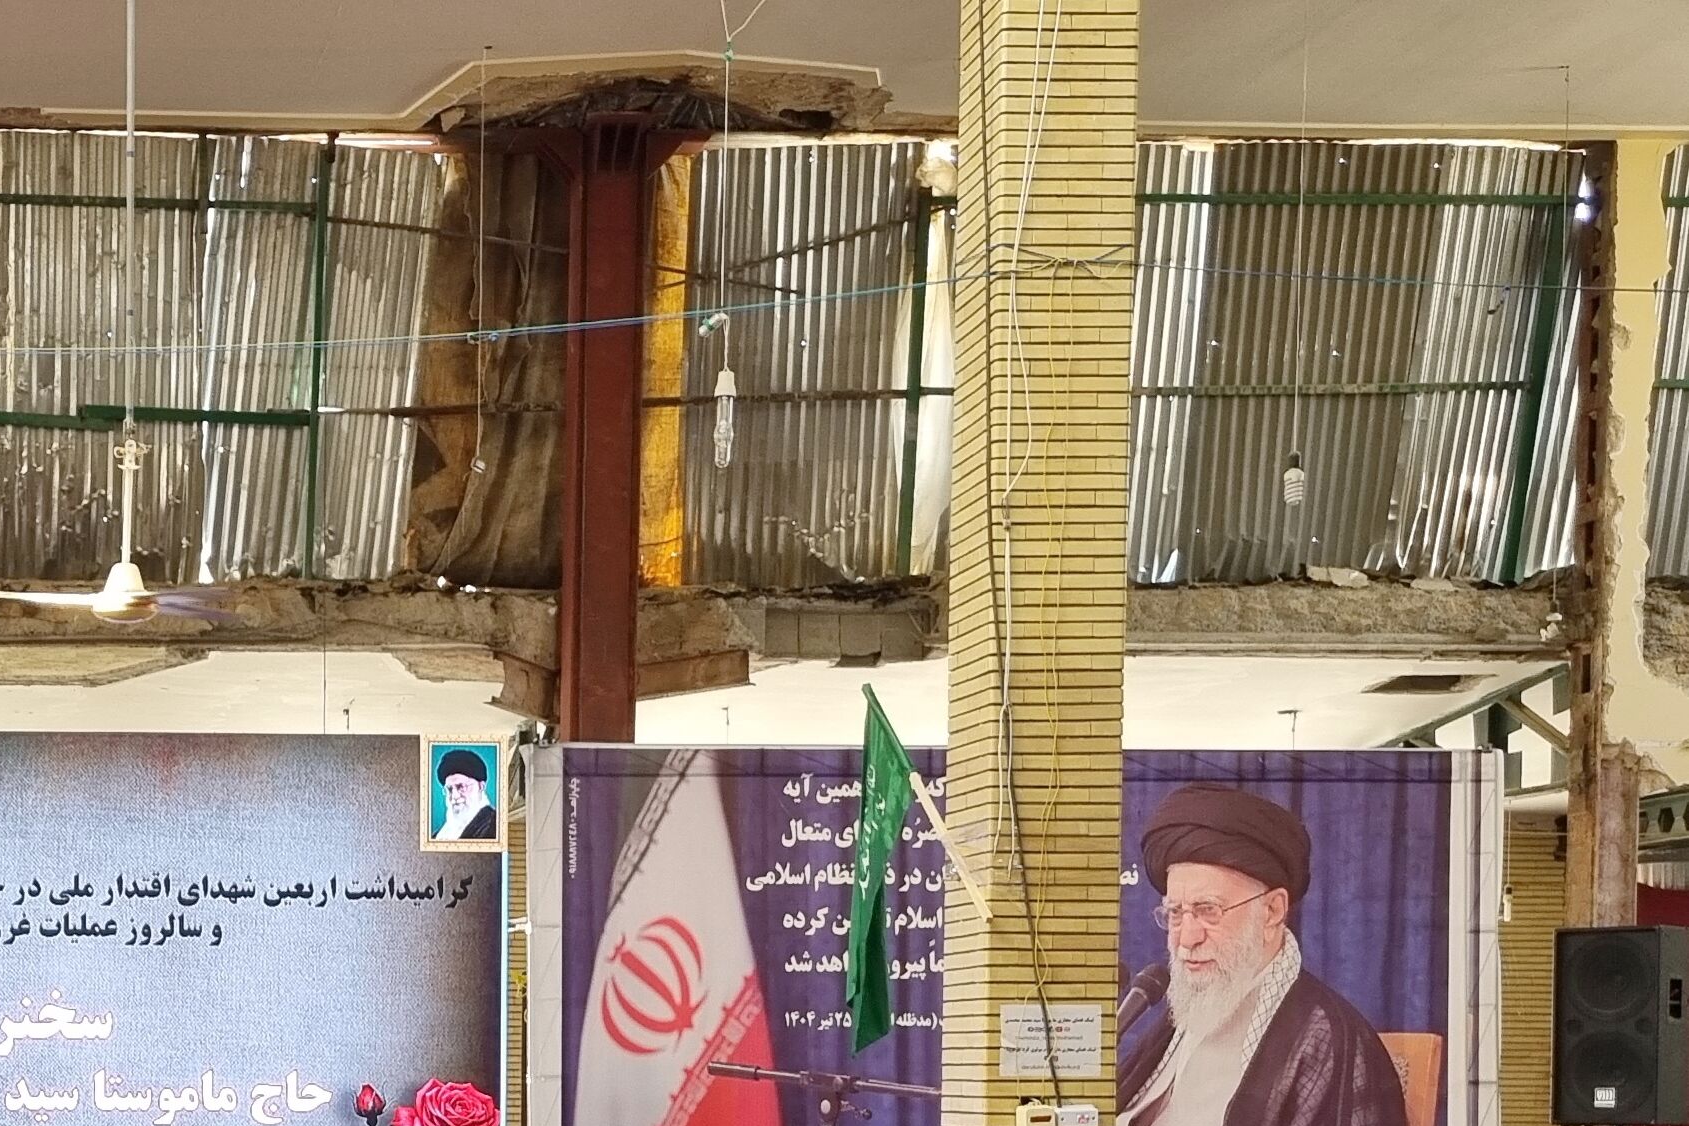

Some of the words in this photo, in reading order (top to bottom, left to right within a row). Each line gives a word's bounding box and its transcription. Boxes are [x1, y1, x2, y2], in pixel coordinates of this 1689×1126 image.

[783, 772, 814, 802] آیه
[781, 818, 831, 848] متعال
[16, 876, 42, 907] در
[49, 873, 94, 906] ملی
[101, 872, 171, 907] اقتدار
[177, 873, 256, 907] شهدای
[263, 873, 336, 907] اربعین
[746, 862, 810, 892] اسلامی
[39, 912, 118, 945] عملیات
[125, 913, 203, 946] سالروز
[209, 922, 223, 946] و
[783, 906, 829, 936] کرده
[895, 905, 943, 936] اسلام
[784, 950, 813, 973] شد
[816, 950, 849, 973] اهد
[784, 1011, 815, 1029] ۱۴۰۴
[4, 1077, 80, 1122] سید
[93, 1069, 238, 1126] ماموستا
[249, 1069, 334, 1125] حاج
